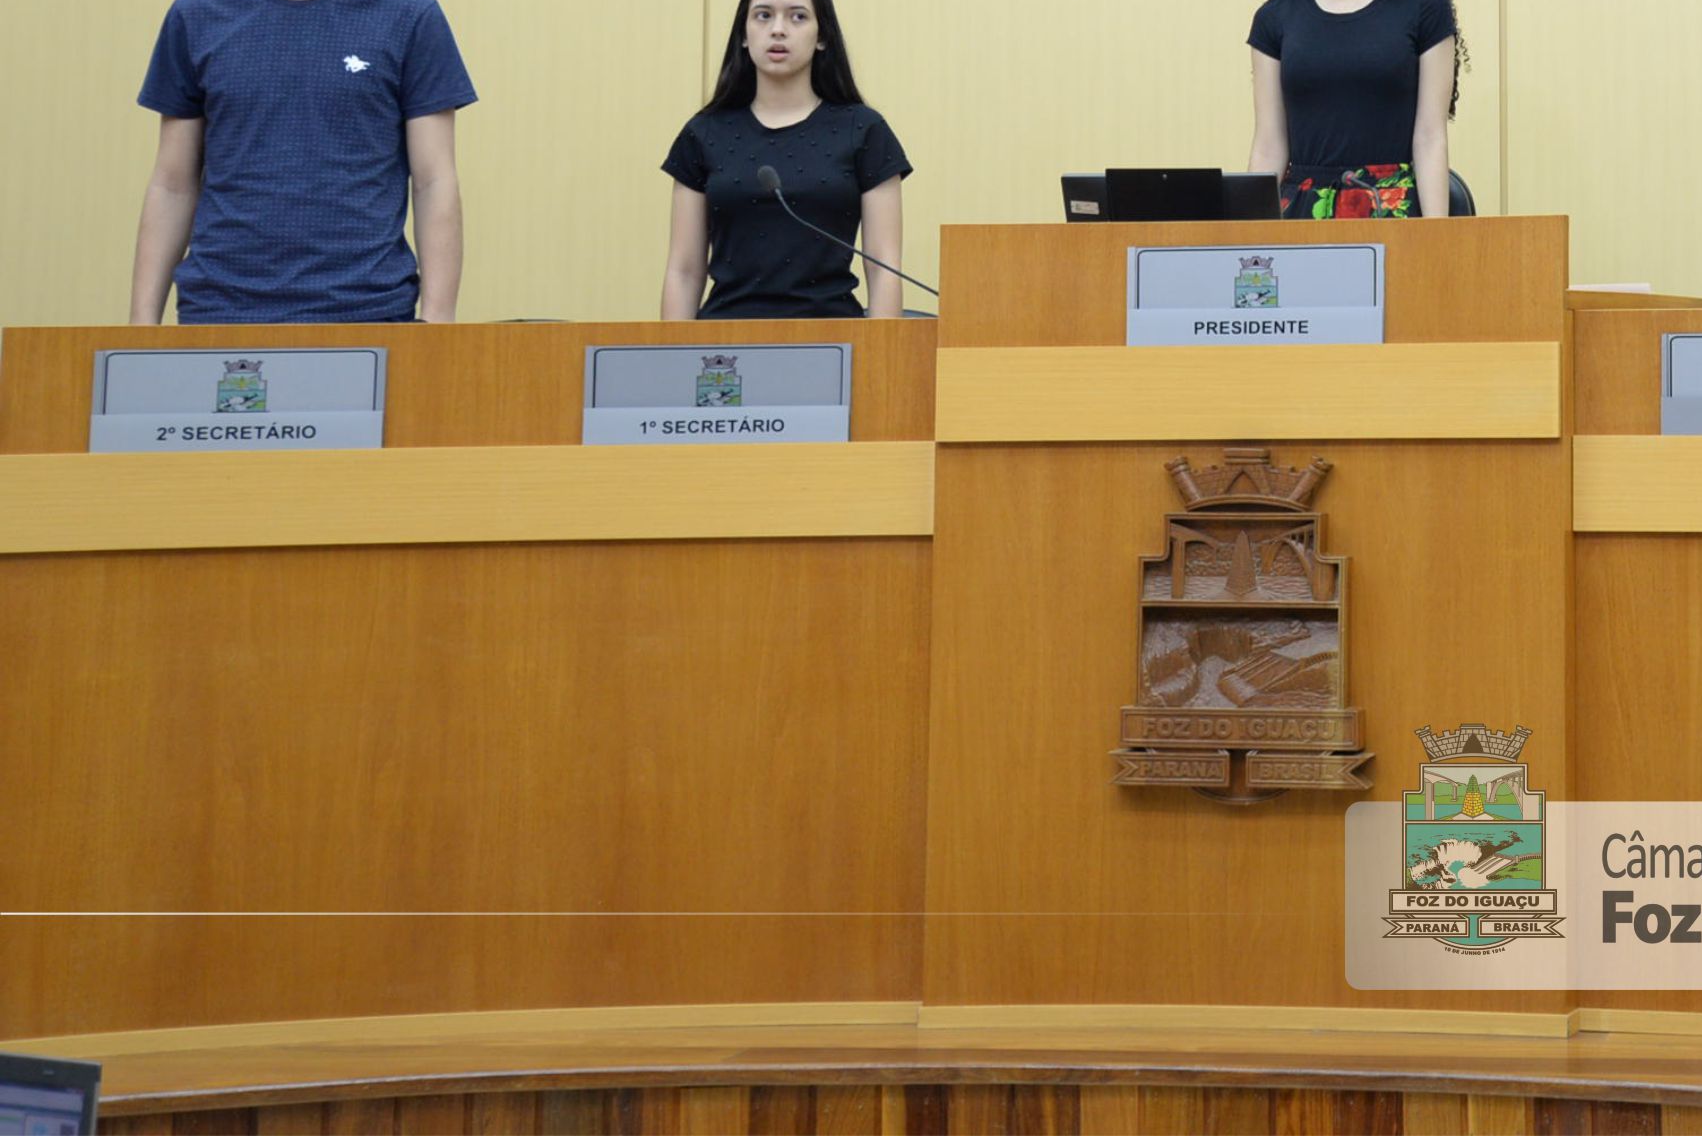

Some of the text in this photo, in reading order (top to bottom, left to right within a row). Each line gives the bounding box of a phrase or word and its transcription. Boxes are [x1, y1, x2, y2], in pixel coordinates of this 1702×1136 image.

[1194, 319, 1310, 336] PRESIDENTE
[181, 422, 317, 441] SECRETÁRIO
[662, 416, 785, 435] SECRETÁRIO
[1143, 717, 1336, 744] FOZ DO IGUAÇU
[1261, 763, 1335, 780] BRASIL
